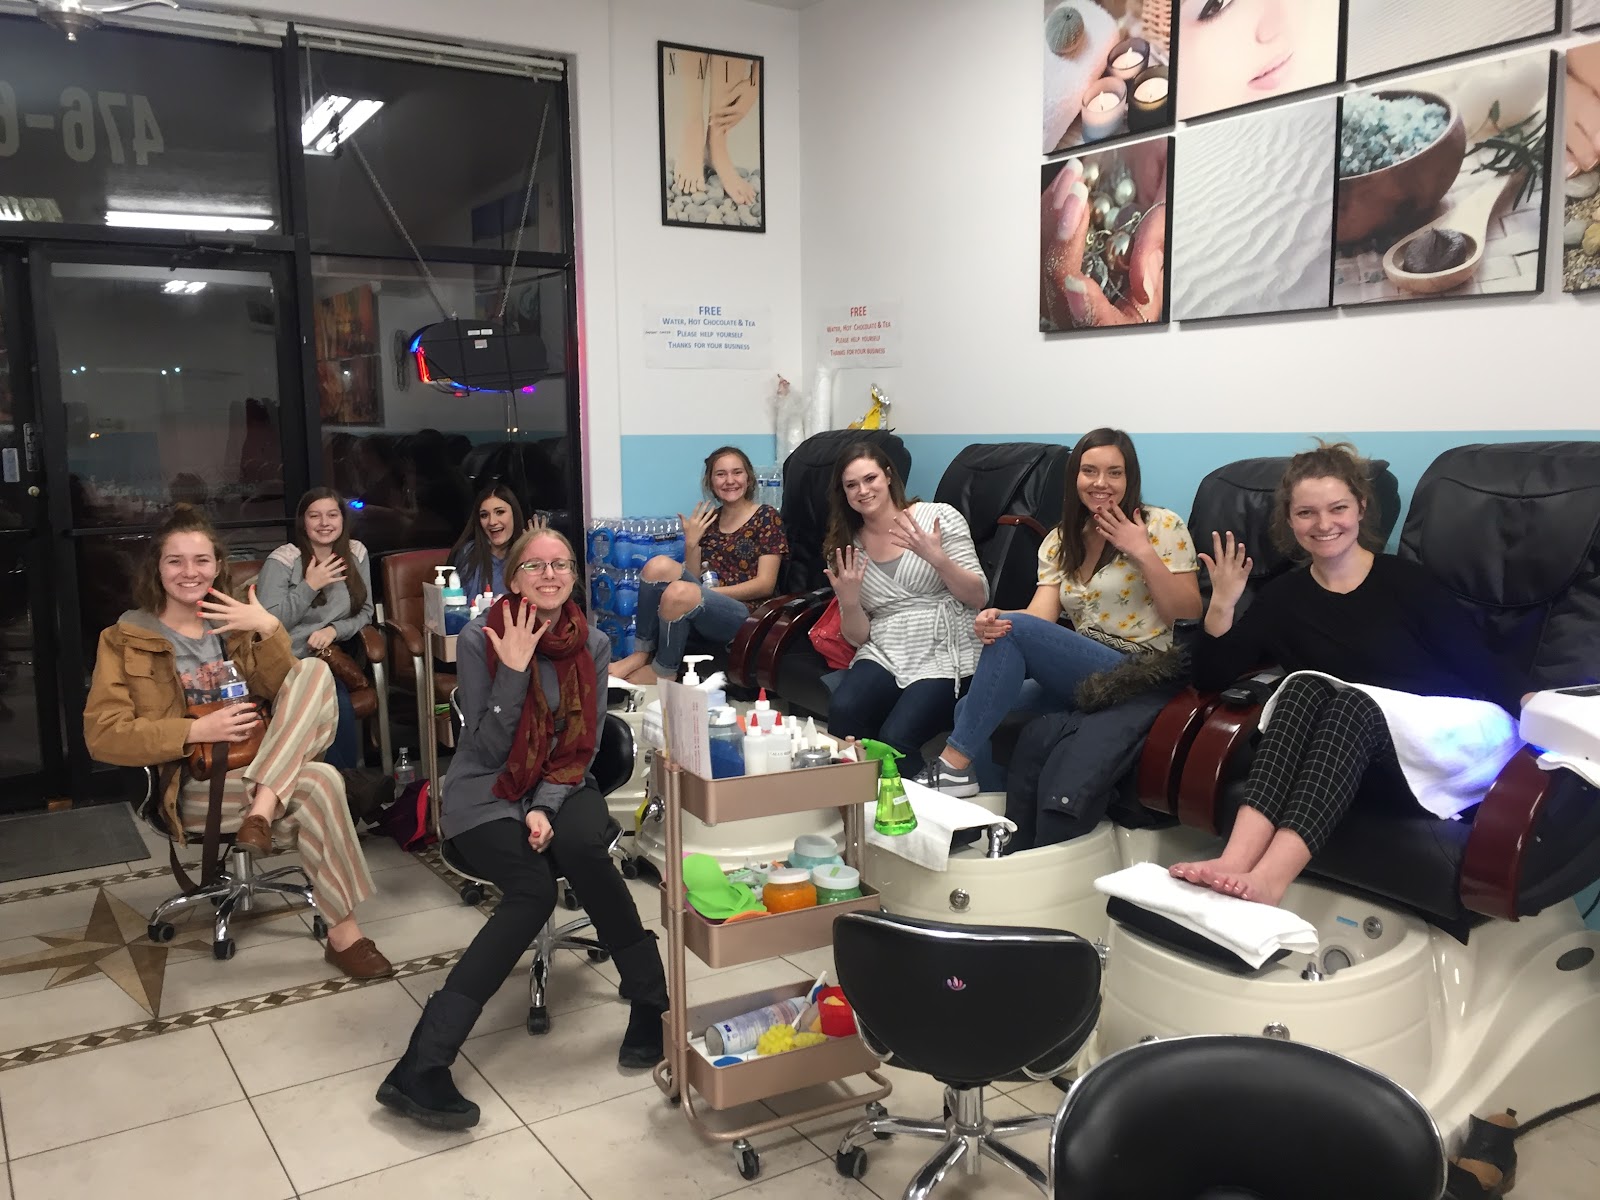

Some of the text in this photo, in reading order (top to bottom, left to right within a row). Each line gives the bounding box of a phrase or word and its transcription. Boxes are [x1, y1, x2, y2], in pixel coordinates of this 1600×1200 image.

[699, 306, 722, 316] FREE
[850, 306, 867, 317] FREE
[662, 318, 687, 326] WATER,
[703, 318, 737, 326] CHOCOLATE
[737, 319, 744, 327] &
[853, 323, 877, 331] CHOCOLATE
[882, 320, 891, 328] TEA
[677, 330, 697, 338] PLEASE
[668, 341, 692, 349] THANKS
